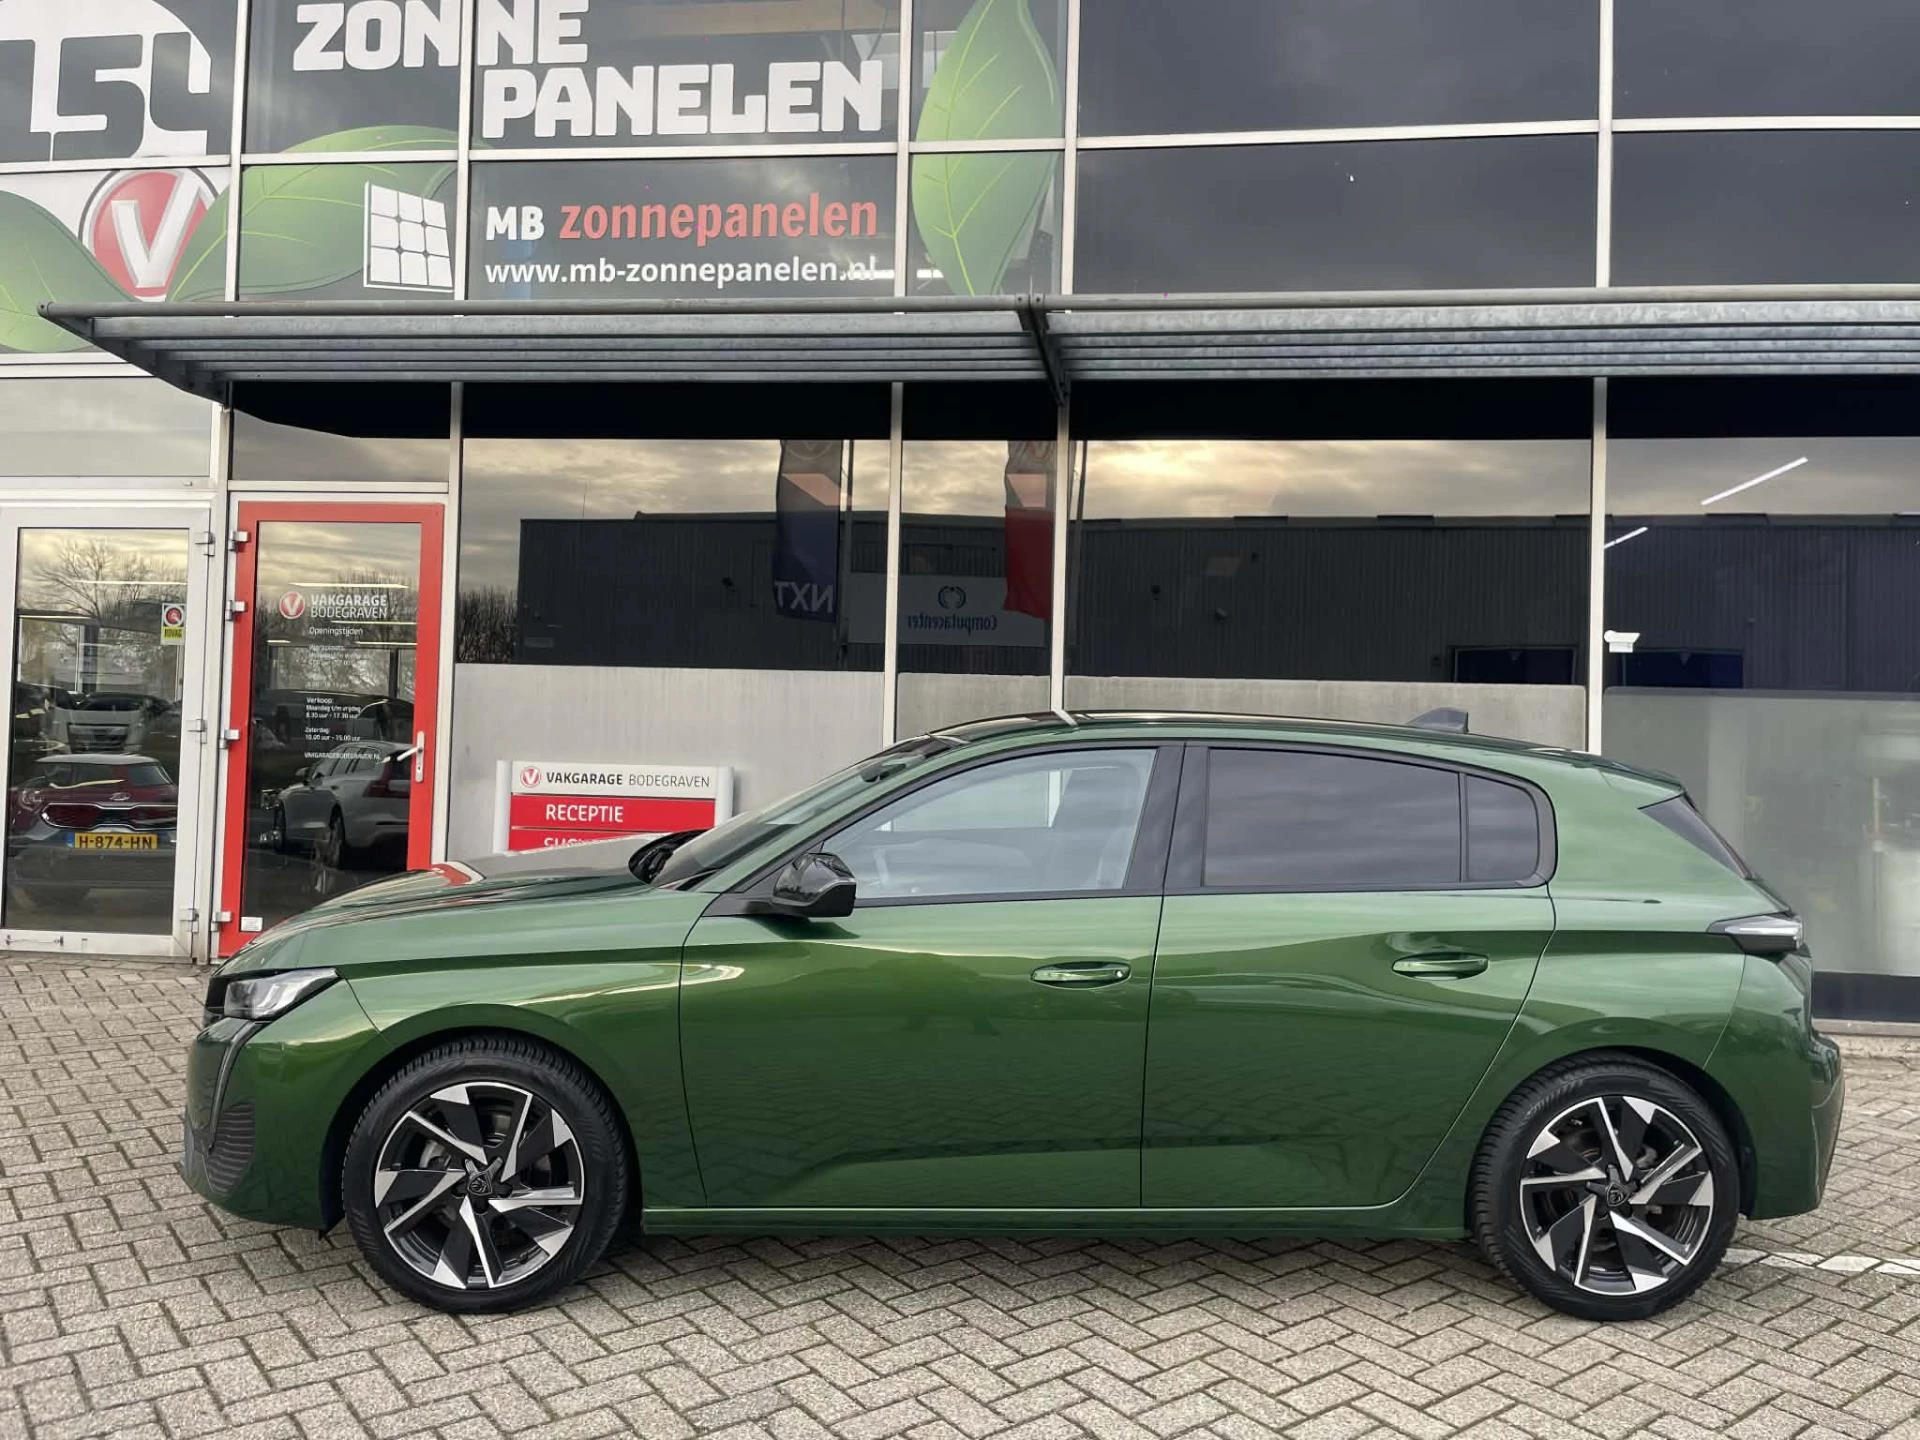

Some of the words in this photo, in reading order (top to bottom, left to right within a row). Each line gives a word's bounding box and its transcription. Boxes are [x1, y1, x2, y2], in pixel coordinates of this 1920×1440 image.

[482, 60, 883, 139] PANELEN
[485, 206, 544, 241] MB
[559, 192, 878, 247] zonnepanelen
[485, 255, 877, 289] www.mb-zonnepanelen.nl
[311, 594, 388, 607] VAKGARAGE
[310, 606, 388, 619] BODEGRAVEN
[546, 772, 623, 785] VAKGARAGE
[628, 774, 710, 788] BODEGRAVEN
[545, 804, 623, 823] RECEPTIE
[79, 835, 152, 849] H-874-HN
